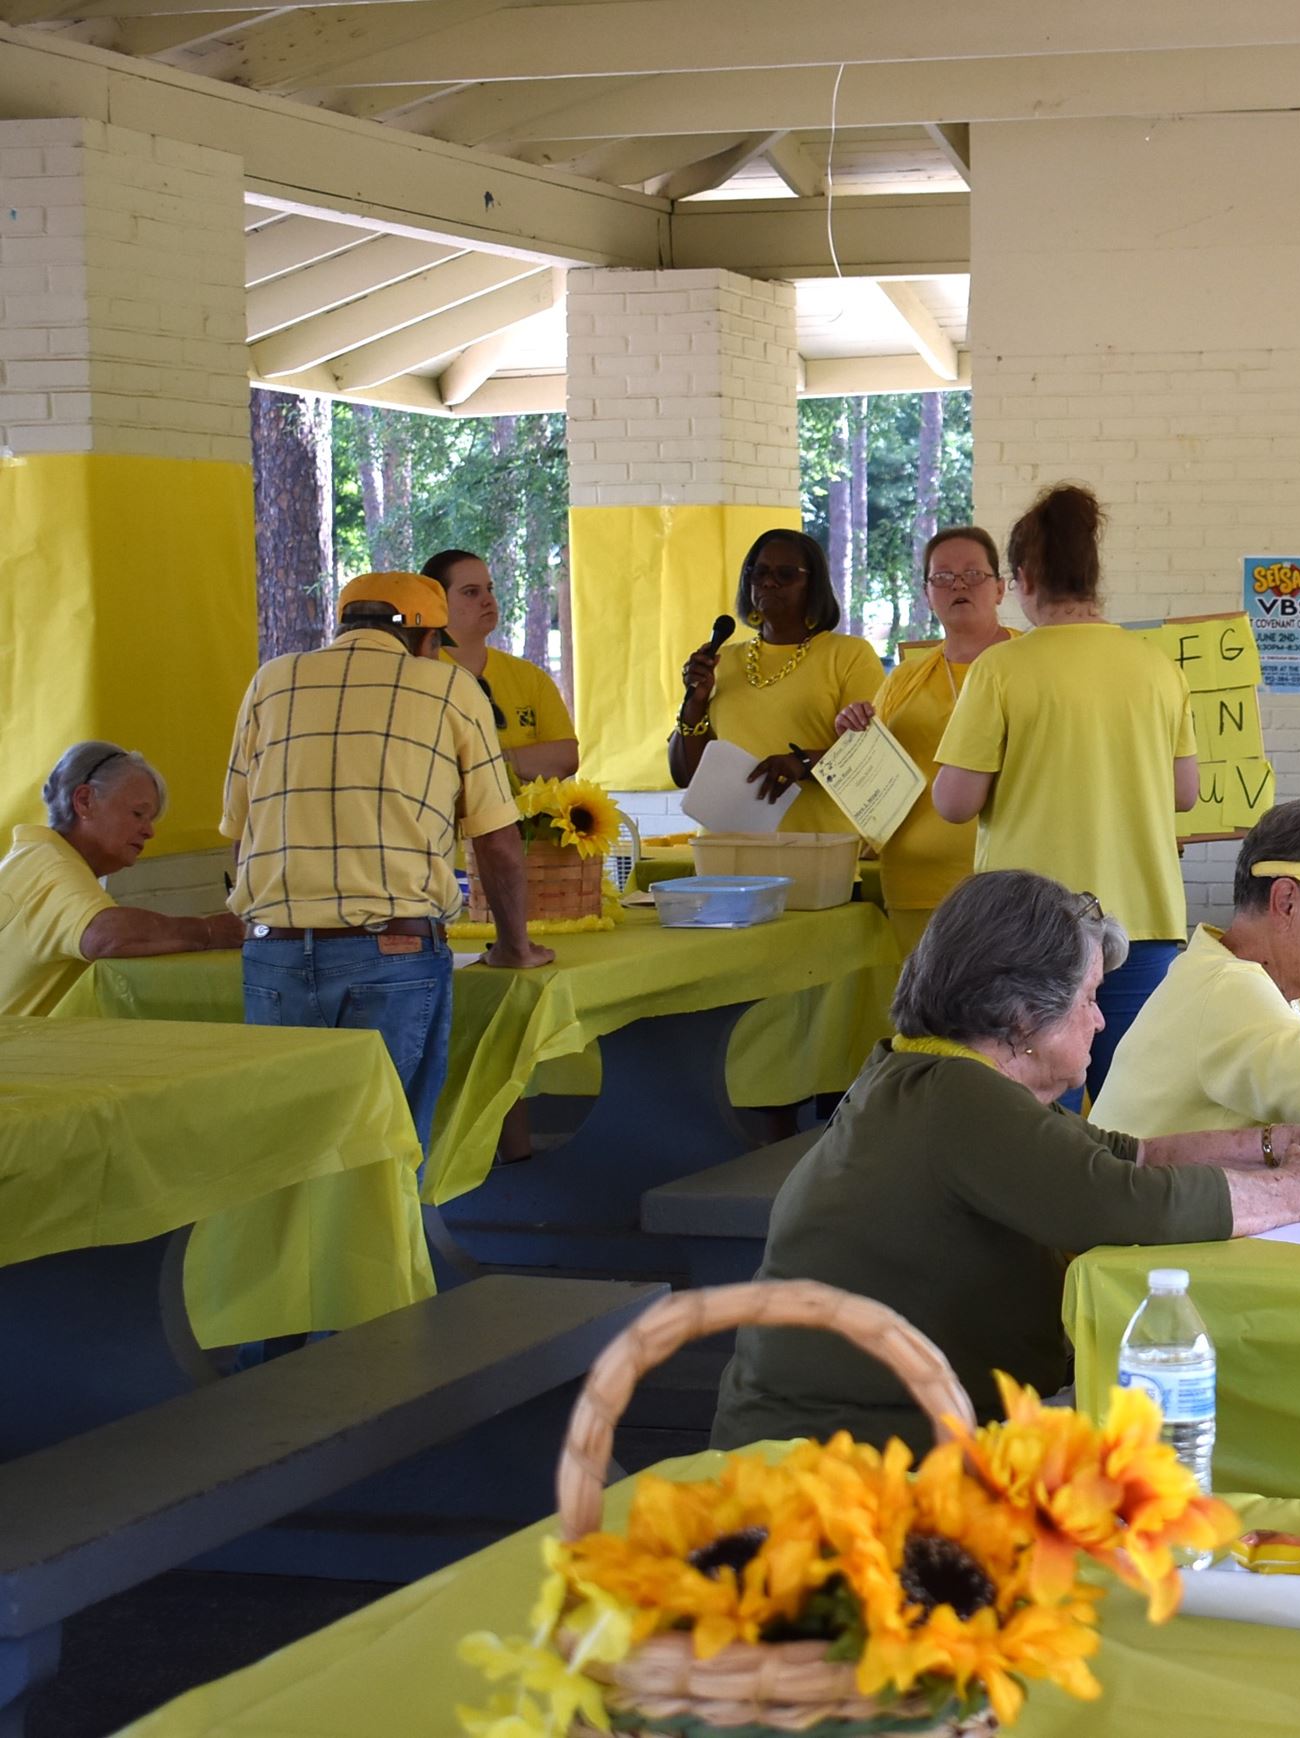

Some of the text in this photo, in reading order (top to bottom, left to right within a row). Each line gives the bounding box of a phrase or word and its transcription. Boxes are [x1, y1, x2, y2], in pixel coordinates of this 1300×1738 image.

[1253, 563, 1281, 593] SET
[1255, 619, 1295, 628] COVENANT
[1256, 633, 1276, 642] JUNE
[1174, 628, 1245, 670] F G
[1219, 700, 1244, 736] N
[1236, 765, 1272, 809] V
